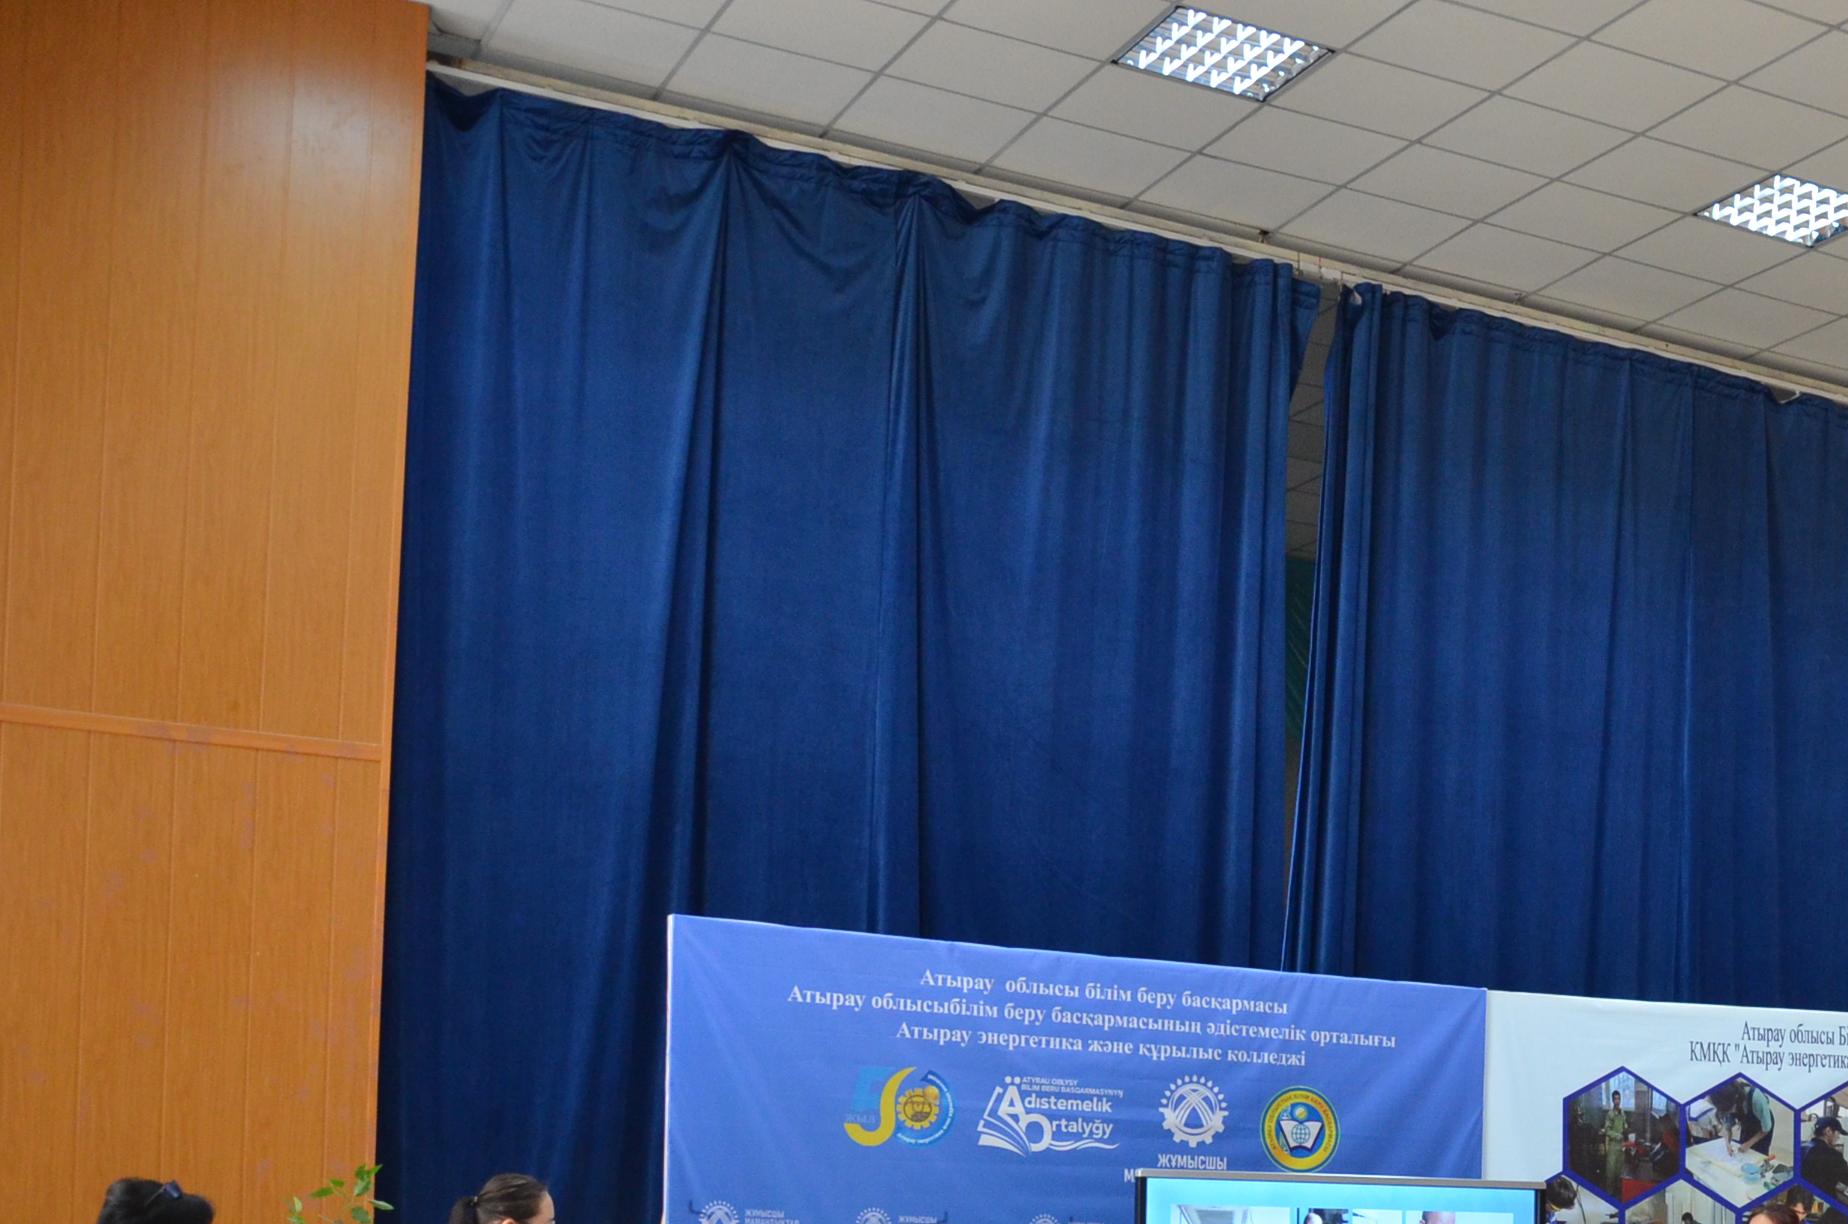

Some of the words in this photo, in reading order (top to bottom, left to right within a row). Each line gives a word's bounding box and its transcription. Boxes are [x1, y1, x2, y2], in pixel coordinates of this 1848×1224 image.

[920, 969, 995, 994] Атырау
[1005, 976, 1080, 998] облысы
[1085, 983, 1132, 1002] білім
[1137, 987, 1176, 1010] беру
[1182, 989, 1288, 1015] басқармасы
[788, 985, 865, 1010] Атырау
[871, 993, 998, 1018] облысыбілім
[1004, 1002, 1045, 1026] беру
[1052, 1006, 1201, 1035] басқармасының
[1207, 1019, 1306, 1042] әдістемелік
[1311, 1030, 1396, 1049] орталығы
[1741, 1020, 1785, 1048] Атырау
[1789, 1024, 1835, 1046] облысы
[897, 1021, 972, 1047] Атырау
[978, 1031, 1082, 1051] энергетика
[1088, 1039, 1133, 1054] және
[1227, 1049, 1306, 1067] колледжі
[1734, 1043, 1785, 1071] "Атырау
[1157, 1153, 1228, 1170] ЖҰМЫСШЫ
